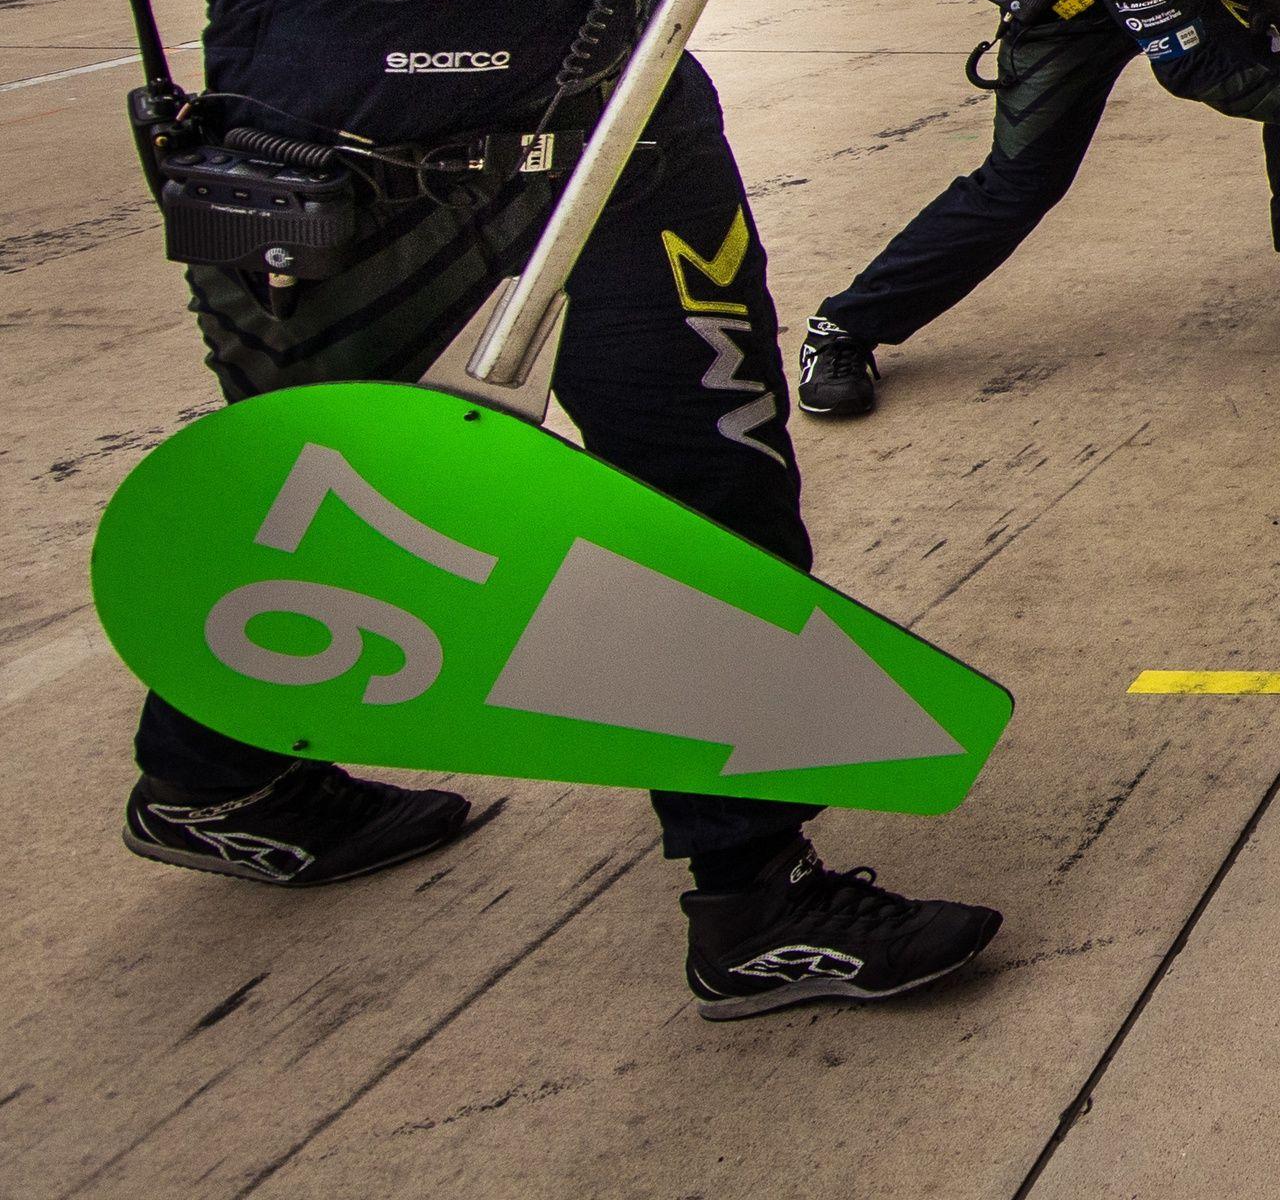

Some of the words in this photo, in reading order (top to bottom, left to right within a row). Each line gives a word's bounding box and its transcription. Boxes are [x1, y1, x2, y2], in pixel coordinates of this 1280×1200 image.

[385, 50, 511, 73] sparco
[660, 203, 787, 469] AMR
[204, 441, 500, 706] 97
